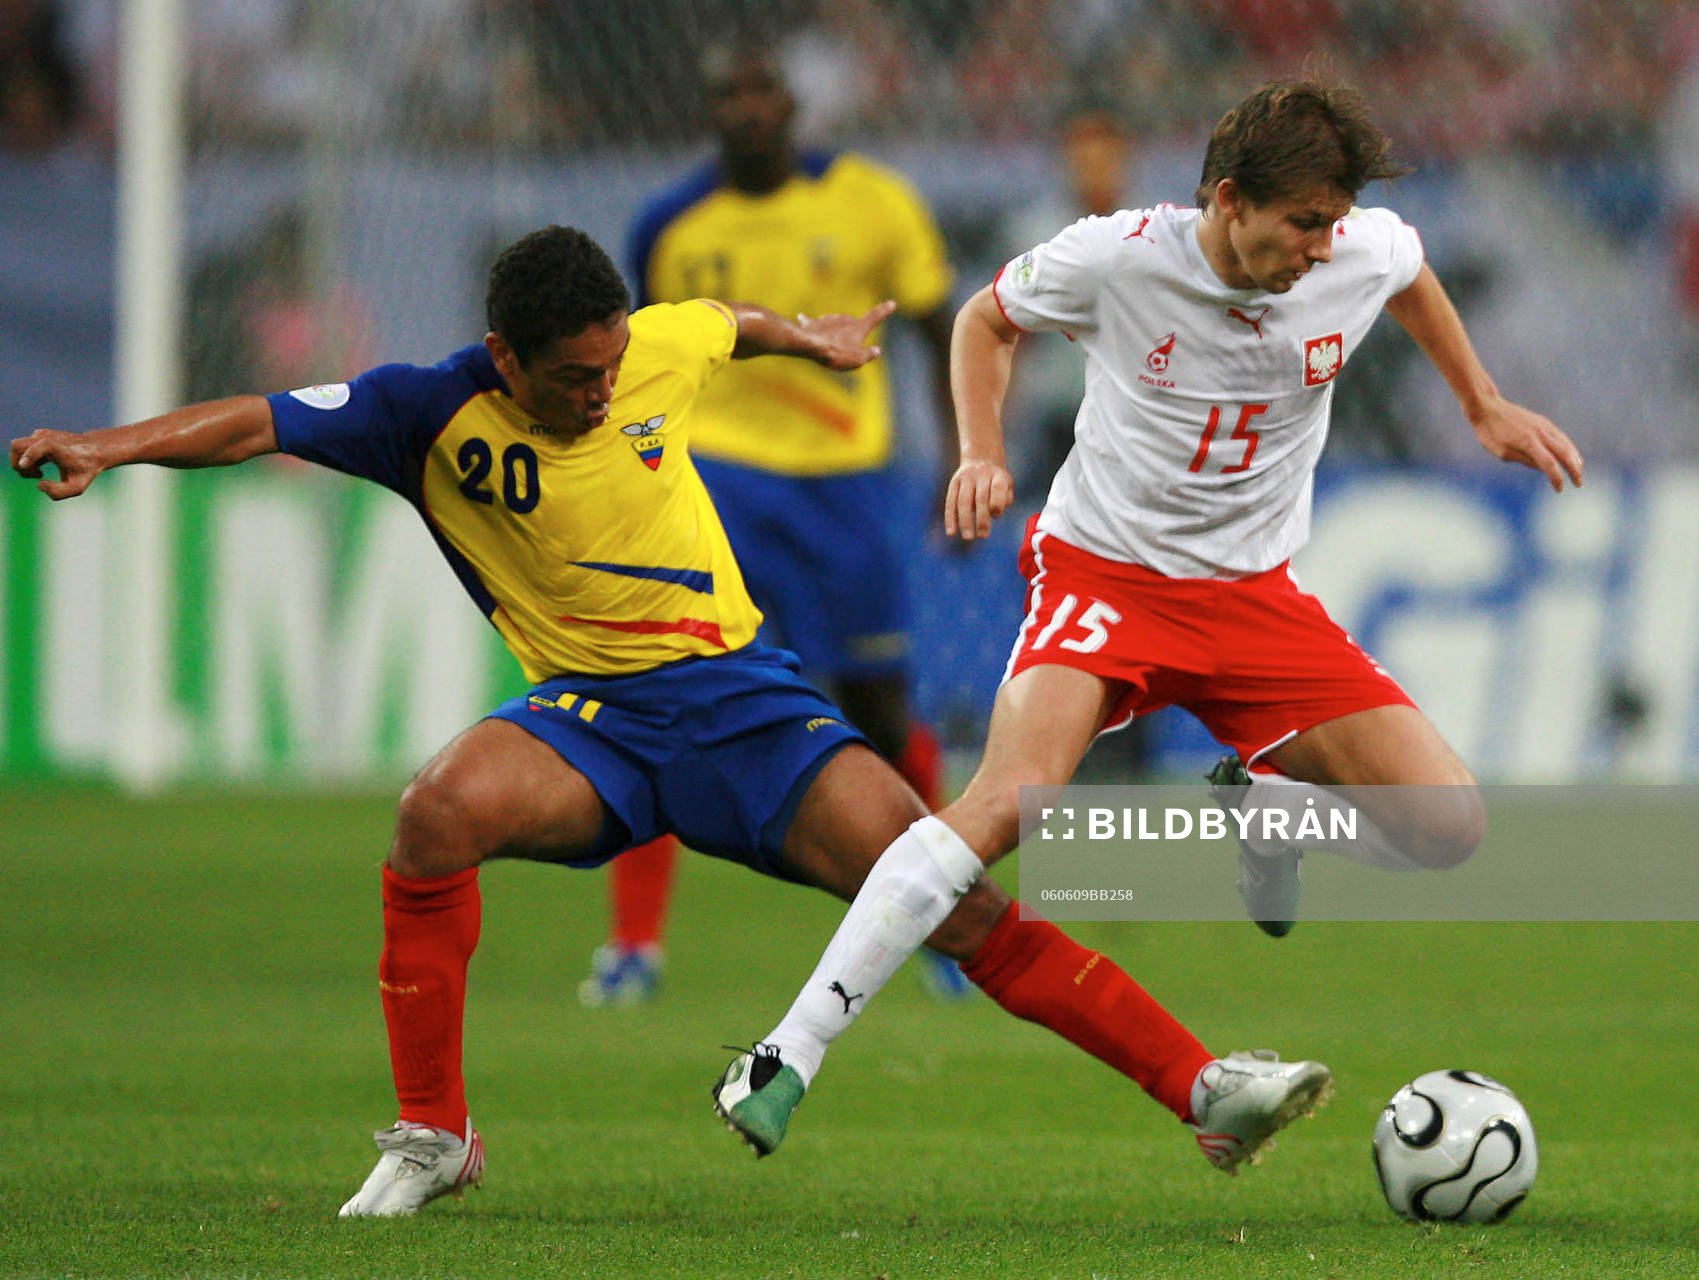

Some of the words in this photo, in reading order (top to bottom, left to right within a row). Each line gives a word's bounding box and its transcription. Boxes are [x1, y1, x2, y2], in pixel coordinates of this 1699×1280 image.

[1188, 403, 1269, 473] 15
[457, 437, 541, 514] 20
[1031, 594, 1122, 653] 15
